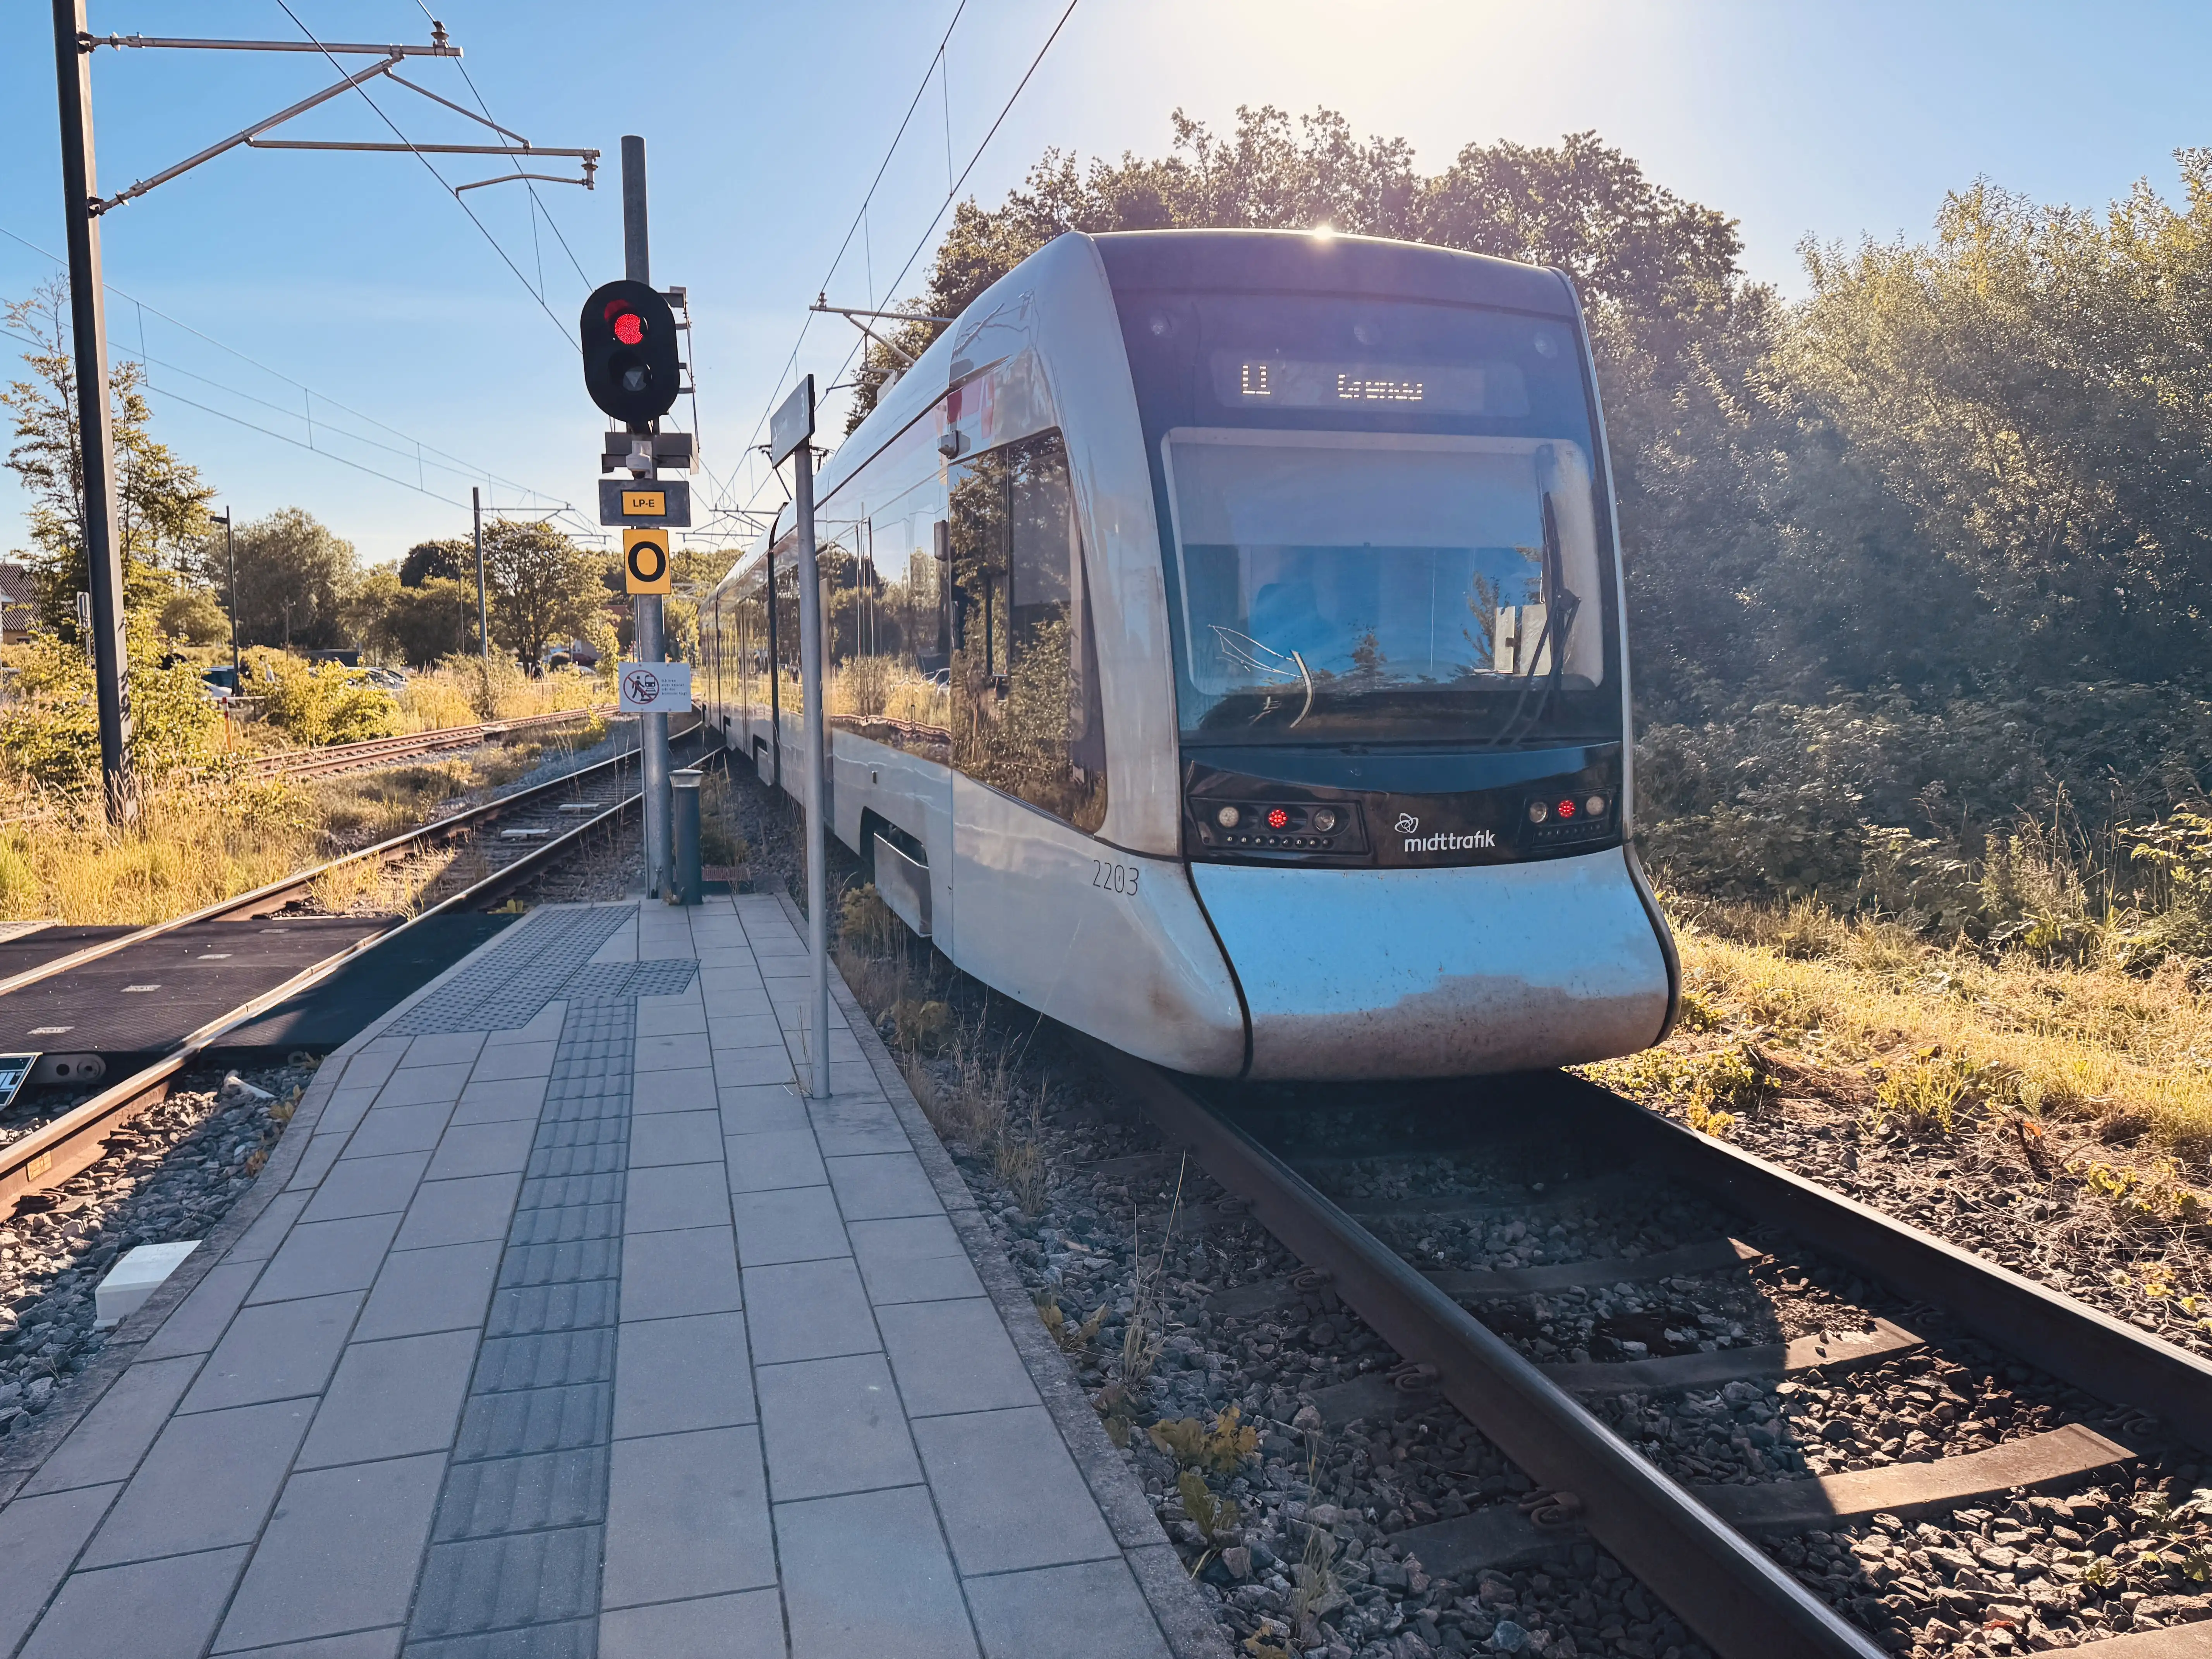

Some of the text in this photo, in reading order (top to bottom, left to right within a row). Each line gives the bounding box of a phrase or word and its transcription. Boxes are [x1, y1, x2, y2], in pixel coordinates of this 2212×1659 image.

[633, 499, 654, 508] LP-E
[1404, 830, 1496, 852] midttrafik
[1093, 860, 1139, 896] 2203
